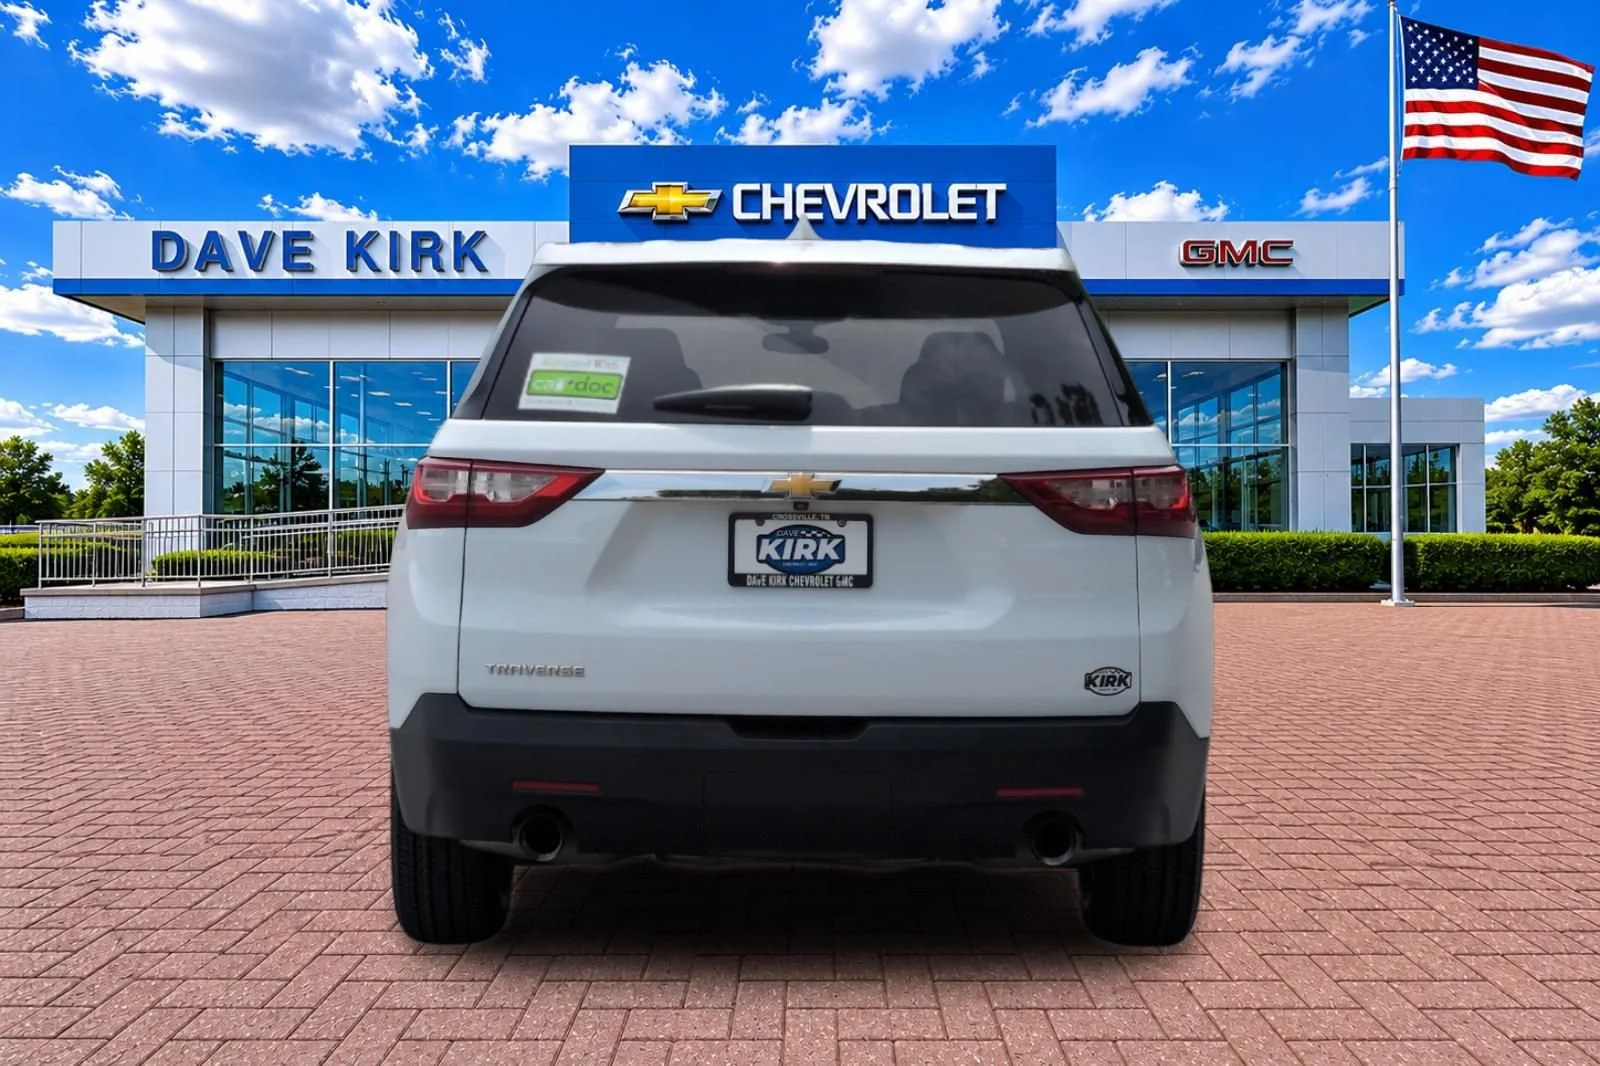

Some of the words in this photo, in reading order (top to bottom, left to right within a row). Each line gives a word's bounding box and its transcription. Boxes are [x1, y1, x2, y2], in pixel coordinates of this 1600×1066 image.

[732, 183, 1007, 221] CHEVROLET
[151, 229, 315, 272] DAVE
[345, 229, 489, 273] KIRK
[1180, 239, 1295, 266] GMC
[776, 529, 800, 537] DAVE
[758, 538, 844, 560] KIRK
[746, 574, 766, 586] DAVE
[768, 575, 787, 587] KIRK
[789, 575, 833, 587] CHEVROLET
[835, 576, 854, 588] GMC
[484, 663, 586, 678] TRAVERSE
[1086, 674, 1130, 688] KIRK
